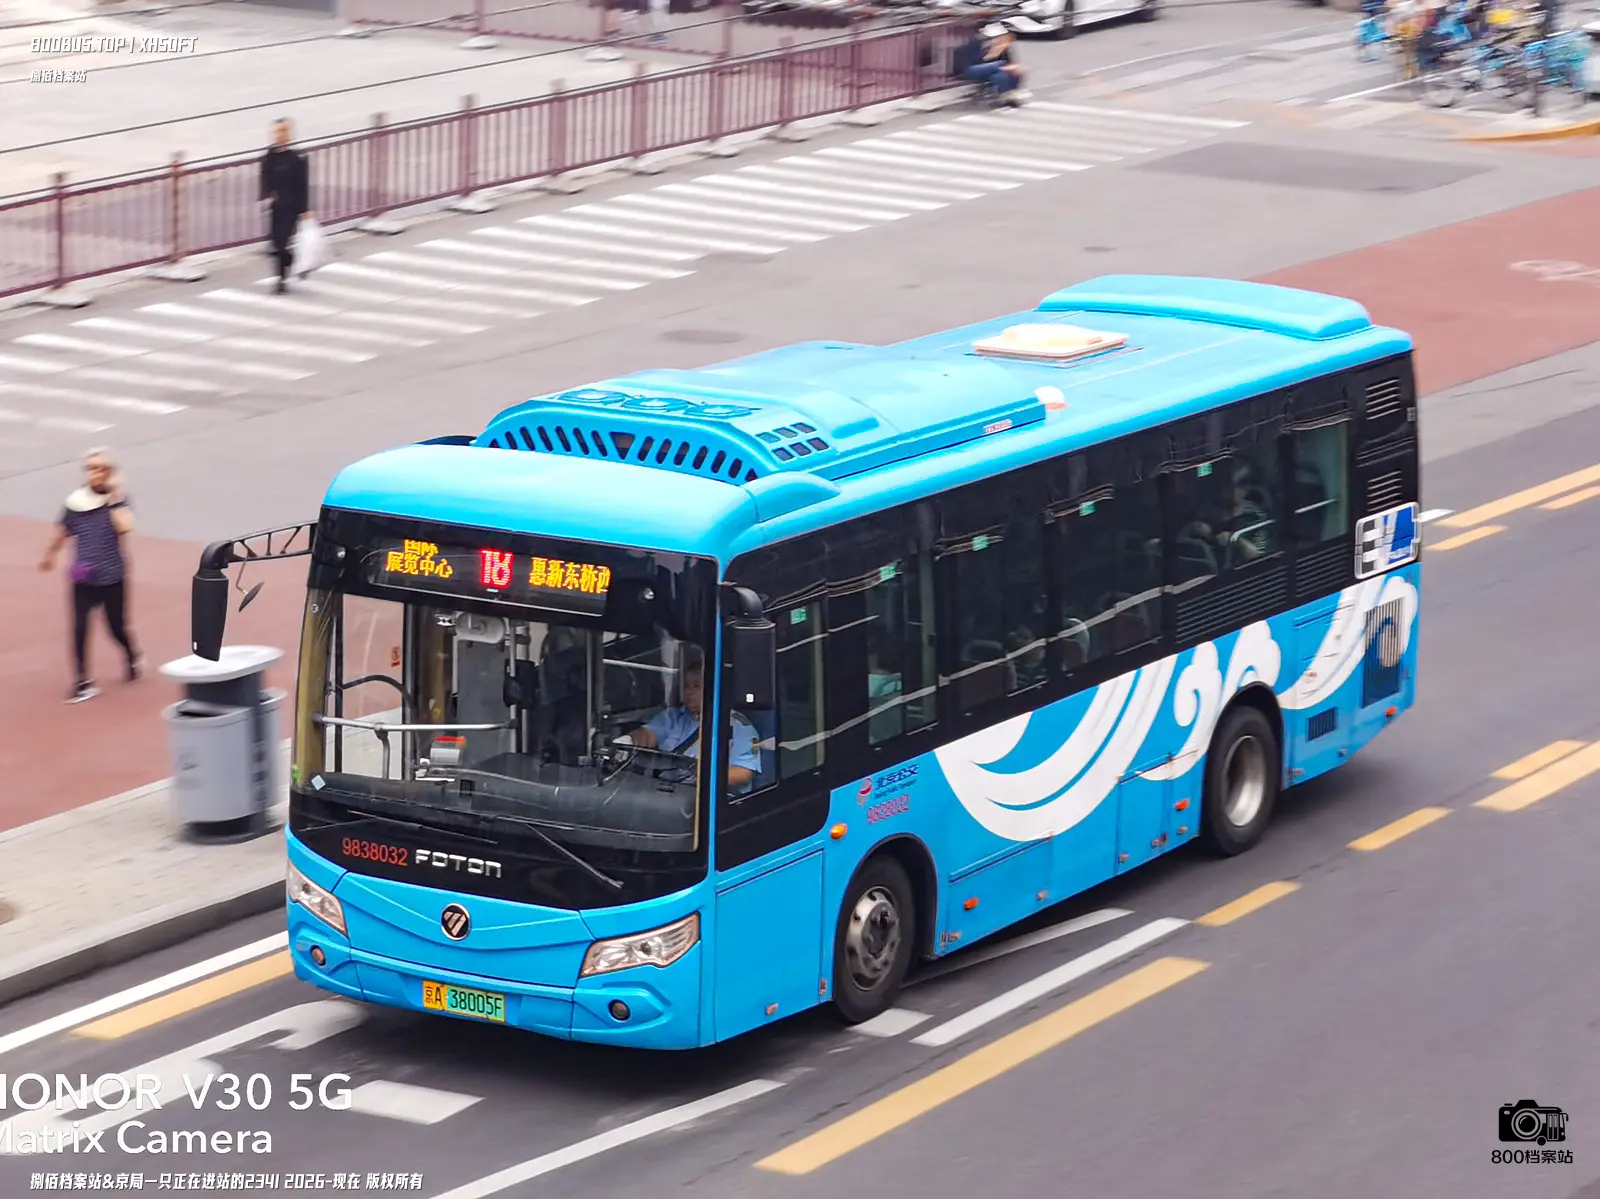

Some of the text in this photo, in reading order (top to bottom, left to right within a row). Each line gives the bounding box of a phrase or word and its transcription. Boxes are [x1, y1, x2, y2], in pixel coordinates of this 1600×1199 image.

[385, 551, 453, 578] 展览中心
[342, 837, 408, 867] 9838032
[414, 848, 503, 879] FOTON
[449, 988, 503, 1017] 38005F
